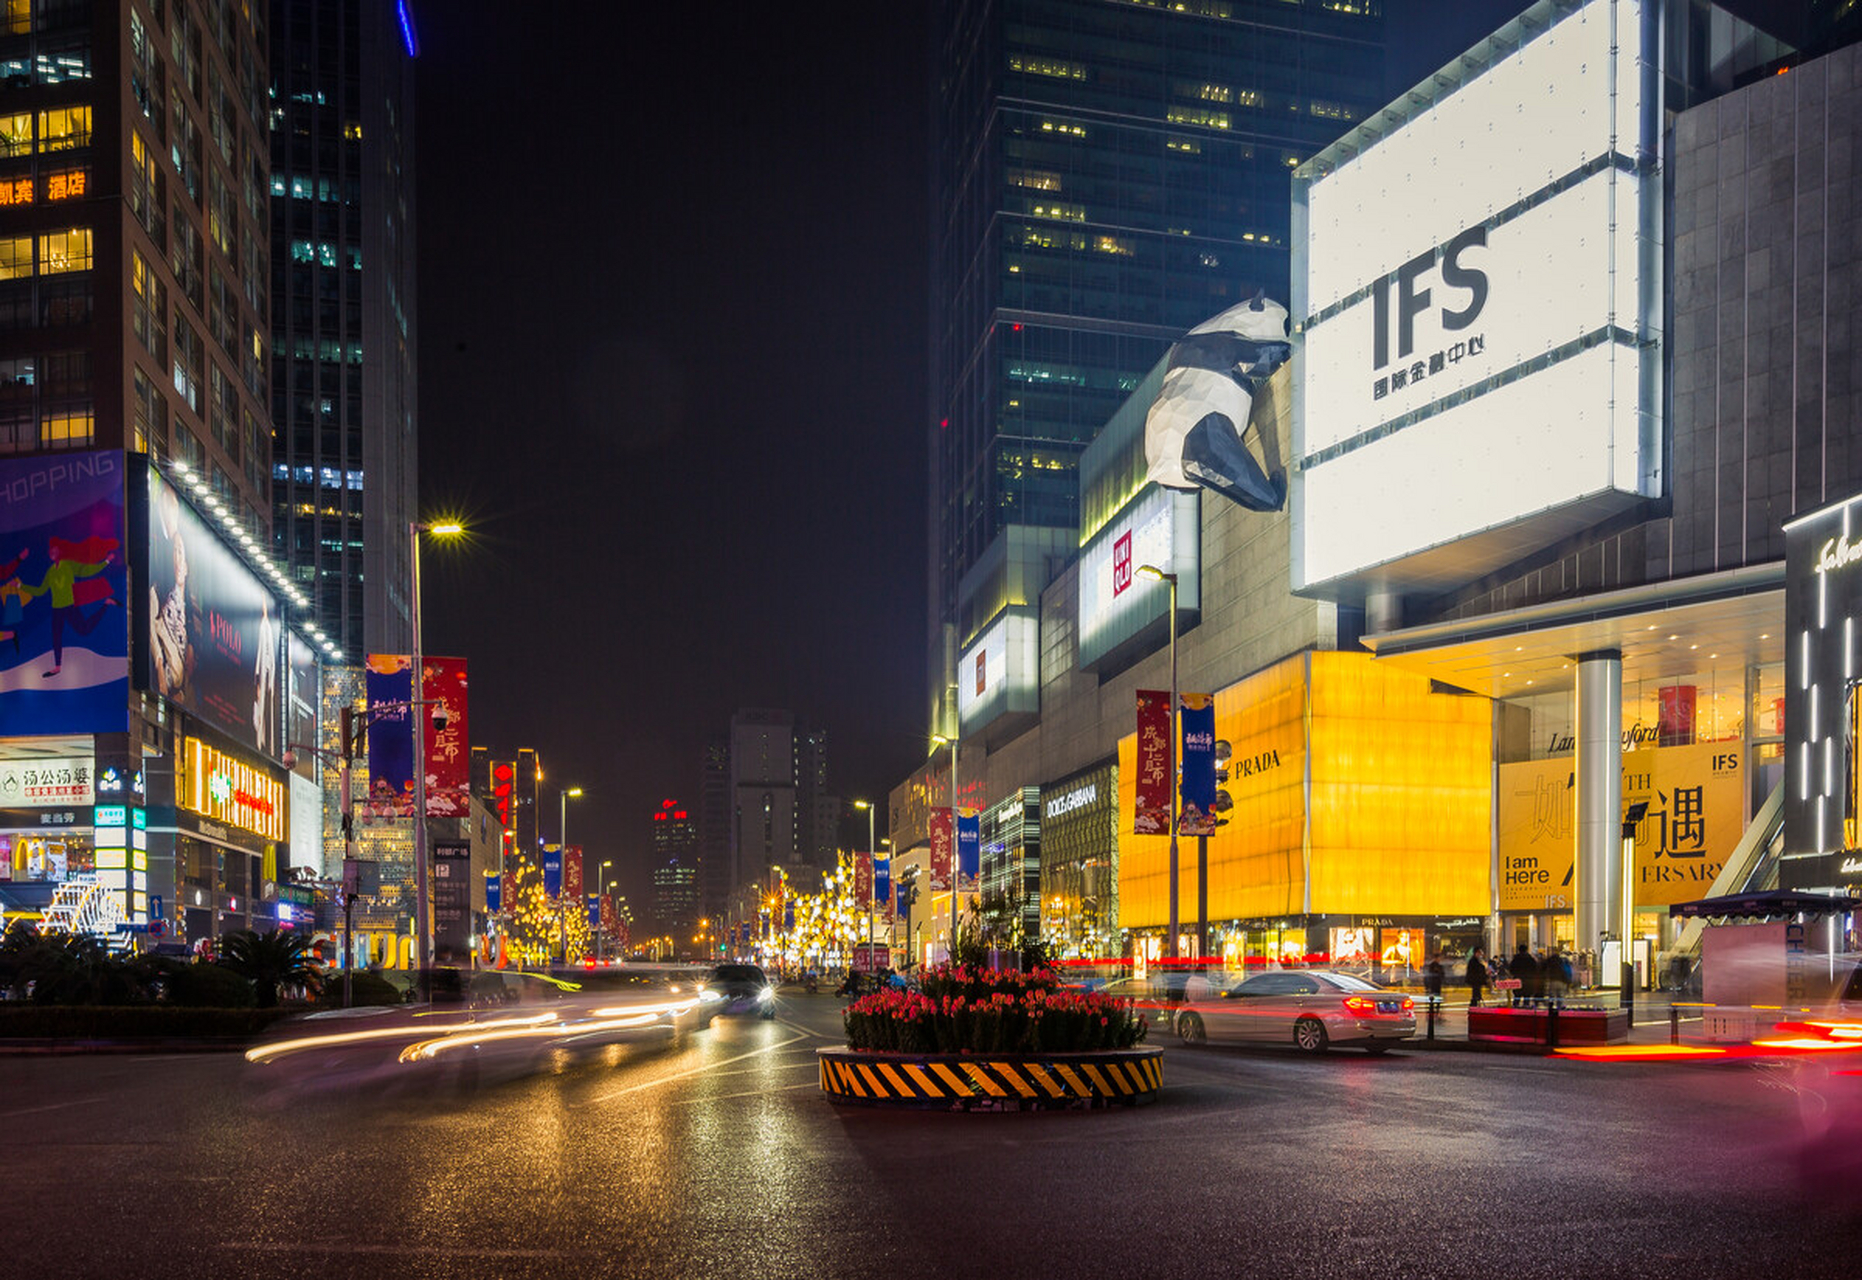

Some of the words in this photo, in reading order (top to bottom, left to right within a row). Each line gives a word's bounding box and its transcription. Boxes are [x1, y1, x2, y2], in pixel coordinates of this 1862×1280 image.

[1373, 226, 1489, 371] IFS
[1373, 333, 1485, 401] 国际金融中心
[1115, 537, 1129, 568] UNI
[1114, 562, 1130, 592] QLO
[1235, 749, 1281, 780] PRADA
[1712, 754, 1738, 771] IFS
[24, 767, 91, 786] 汤公汤婆
[1505, 856, 1510, 869] I
[1513, 858, 1538, 869] am
[1505, 870, 1550, 885] Here
[1544, 894, 1566, 909] IFS
[1361, 917, 1394, 927] PRADA
